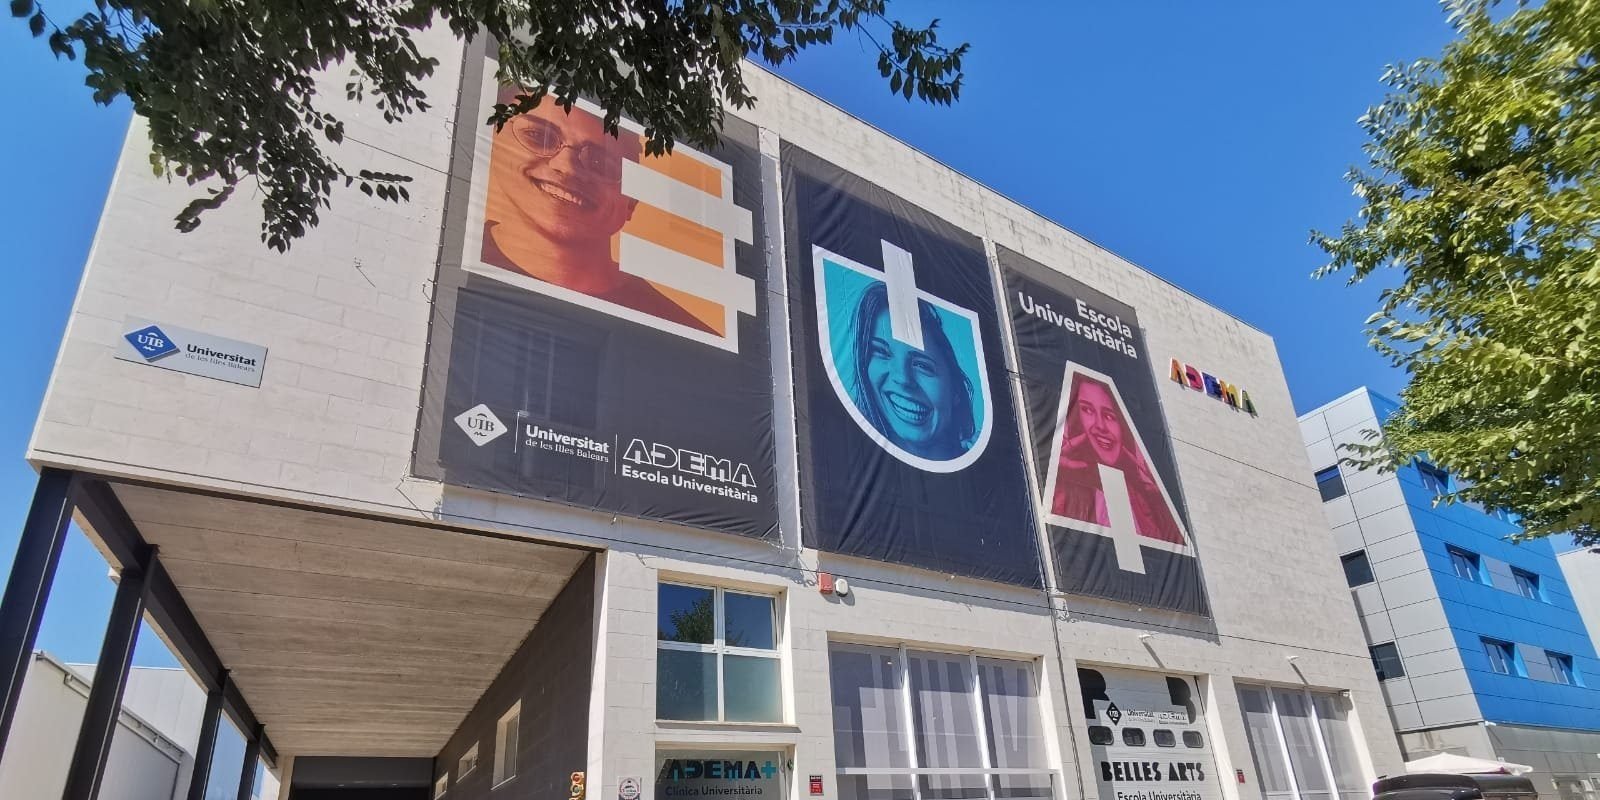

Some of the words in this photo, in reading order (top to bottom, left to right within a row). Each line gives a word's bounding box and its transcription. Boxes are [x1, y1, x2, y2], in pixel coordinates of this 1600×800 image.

[1018, 291, 1138, 360] Universitària
[1075, 298, 1133, 339] Escola
[137, 334, 164, 348] UIB
[187, 344, 256, 366] Universitat
[1168, 356, 1260, 418] ADEMA
[467, 416, 495, 432] UIB
[525, 424, 610, 453] Universitat
[525, 438, 538, 447] de
[540, 440, 554, 451] les
[555, 444, 575, 456] Illes
[576, 448, 609, 463] Balears
[622, 438, 757, 488] ADEMA
[621, 464, 669, 486] Escola
[672, 474, 759, 504] Universitària
[1100, 761, 1162, 782] BELLES
[1168, 762, 1205, 782] ARTS
[701, 784, 763, 796] Universitària
